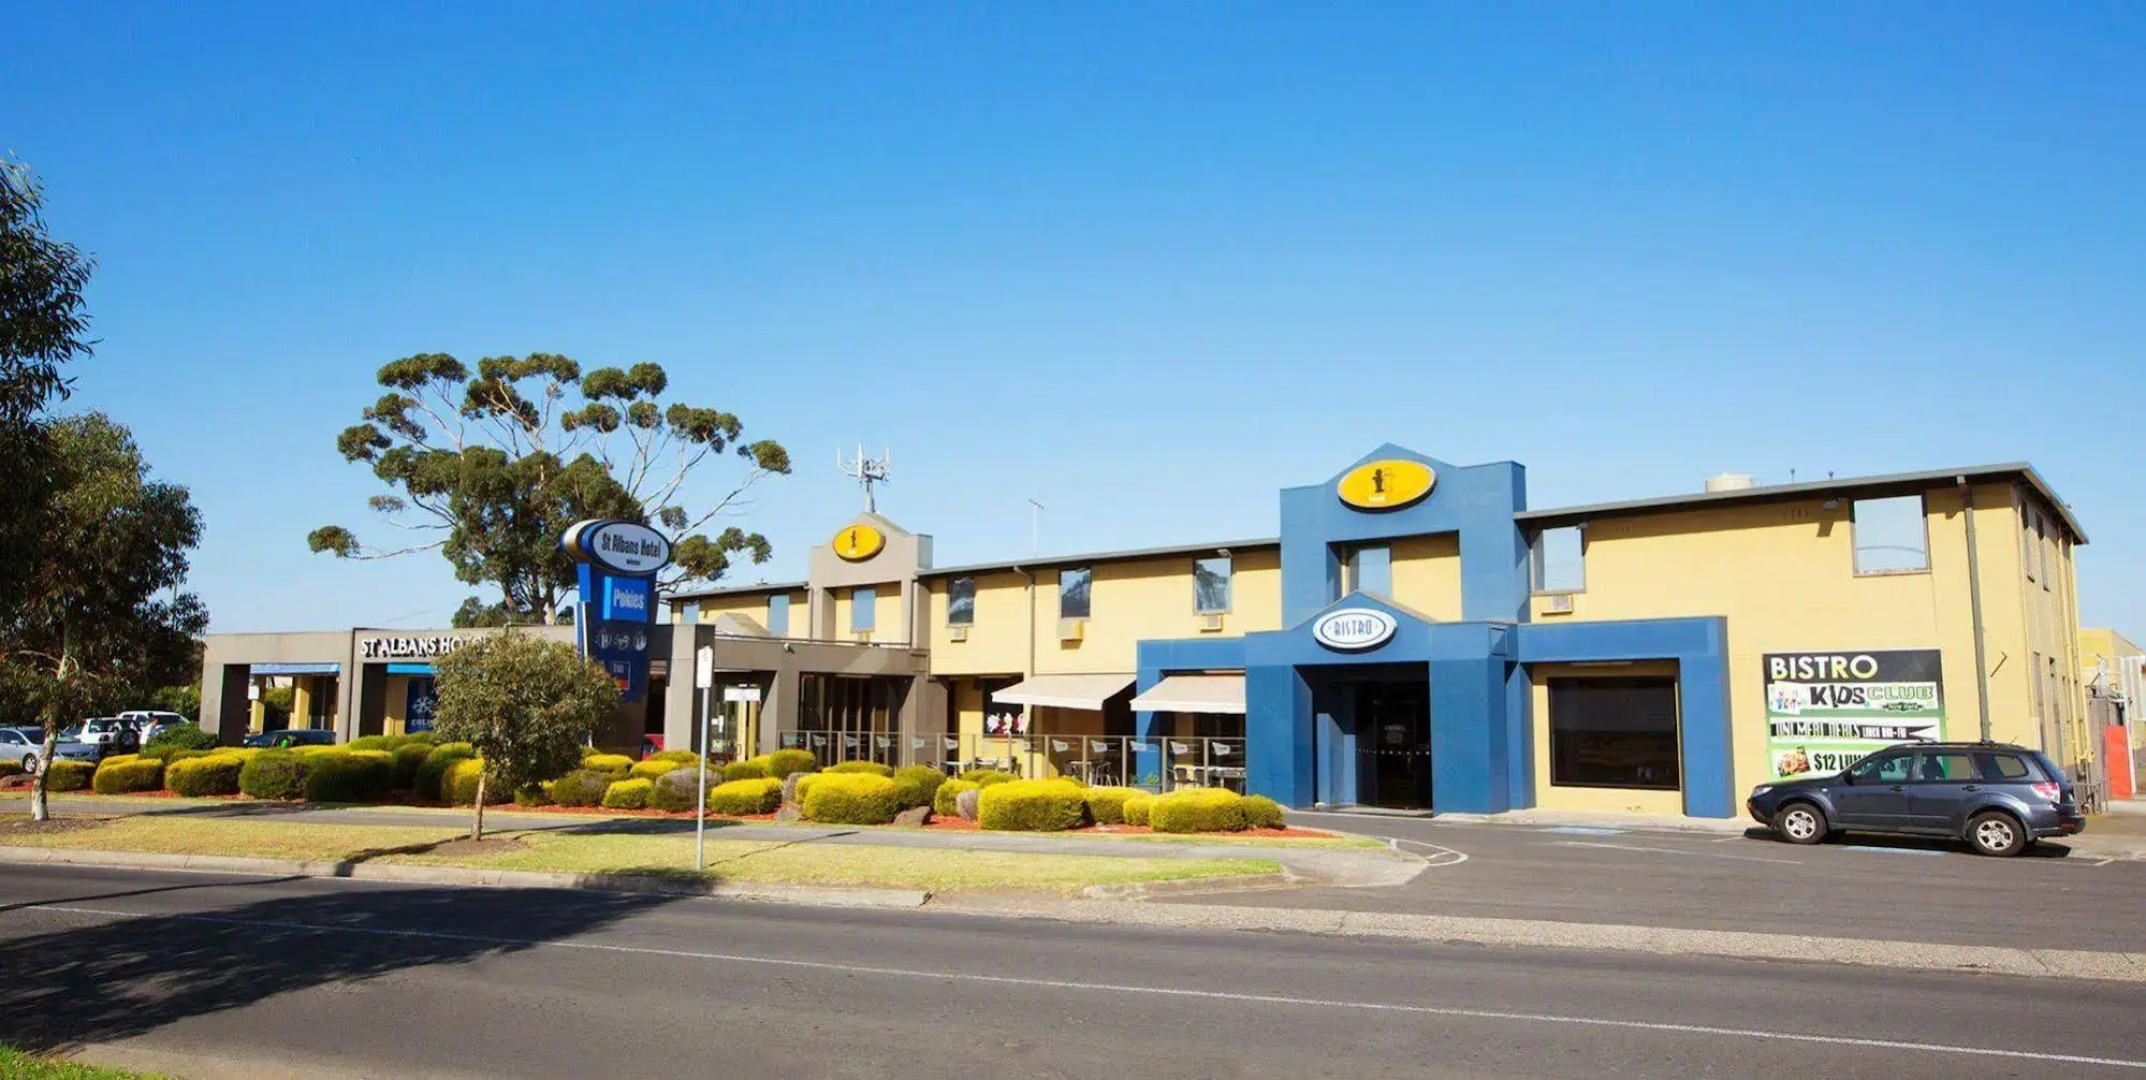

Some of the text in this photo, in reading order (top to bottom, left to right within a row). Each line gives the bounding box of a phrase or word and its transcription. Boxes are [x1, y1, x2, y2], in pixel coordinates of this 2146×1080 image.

[602, 532, 661, 559] St Albans Hotel
[613, 587, 645, 610] Pokies
[1334, 620, 1373, 637] BISTRO
[361, 635, 486, 656] ST ALBANS HOT
[1770, 655, 1878, 680] BISTRO
[1810, 685, 1866, 709] KIDS
[1867, 686, 1934, 701] CLUB
[1814, 753, 1836, 771] $12
